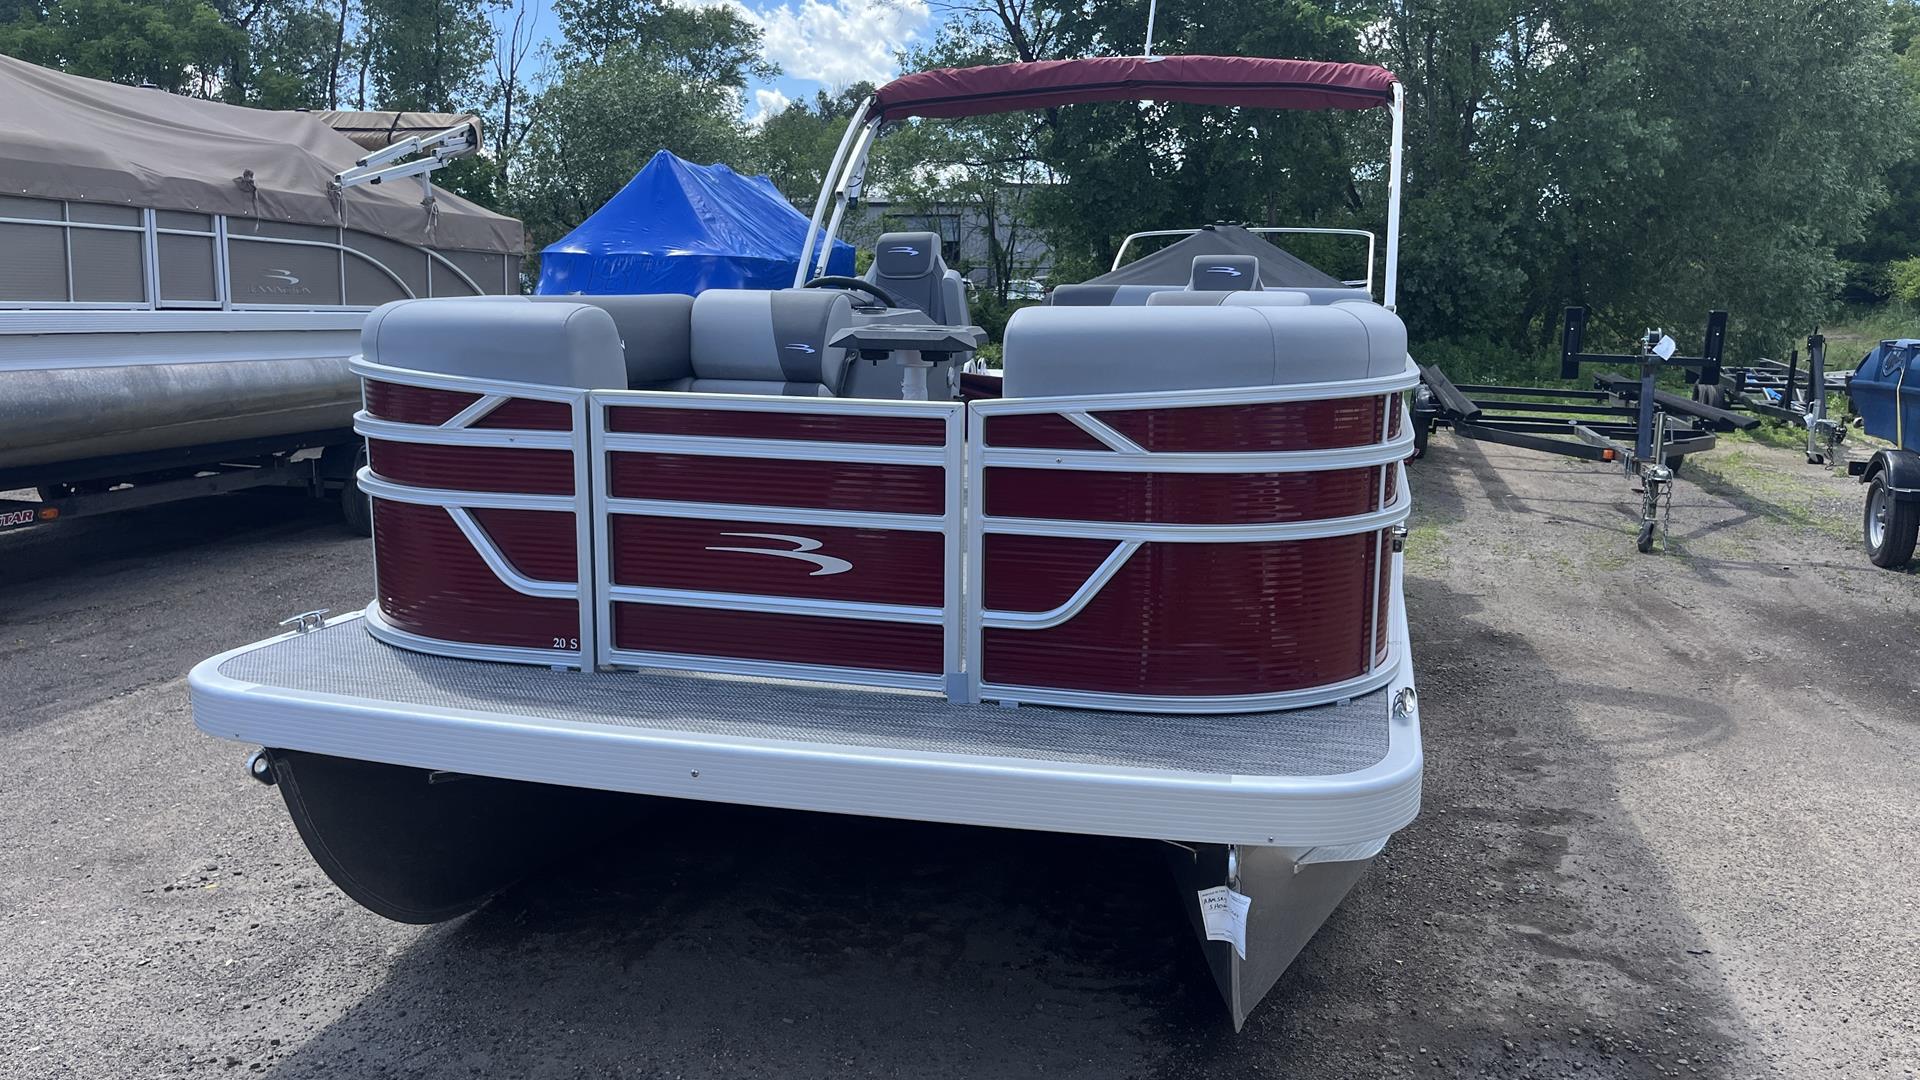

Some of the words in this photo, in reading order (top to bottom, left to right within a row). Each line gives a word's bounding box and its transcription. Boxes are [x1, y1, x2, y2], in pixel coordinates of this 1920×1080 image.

[0, 509, 34, 527] TAR
[553, 637, 566, 649] 20
[570, 638, 578, 650] S
